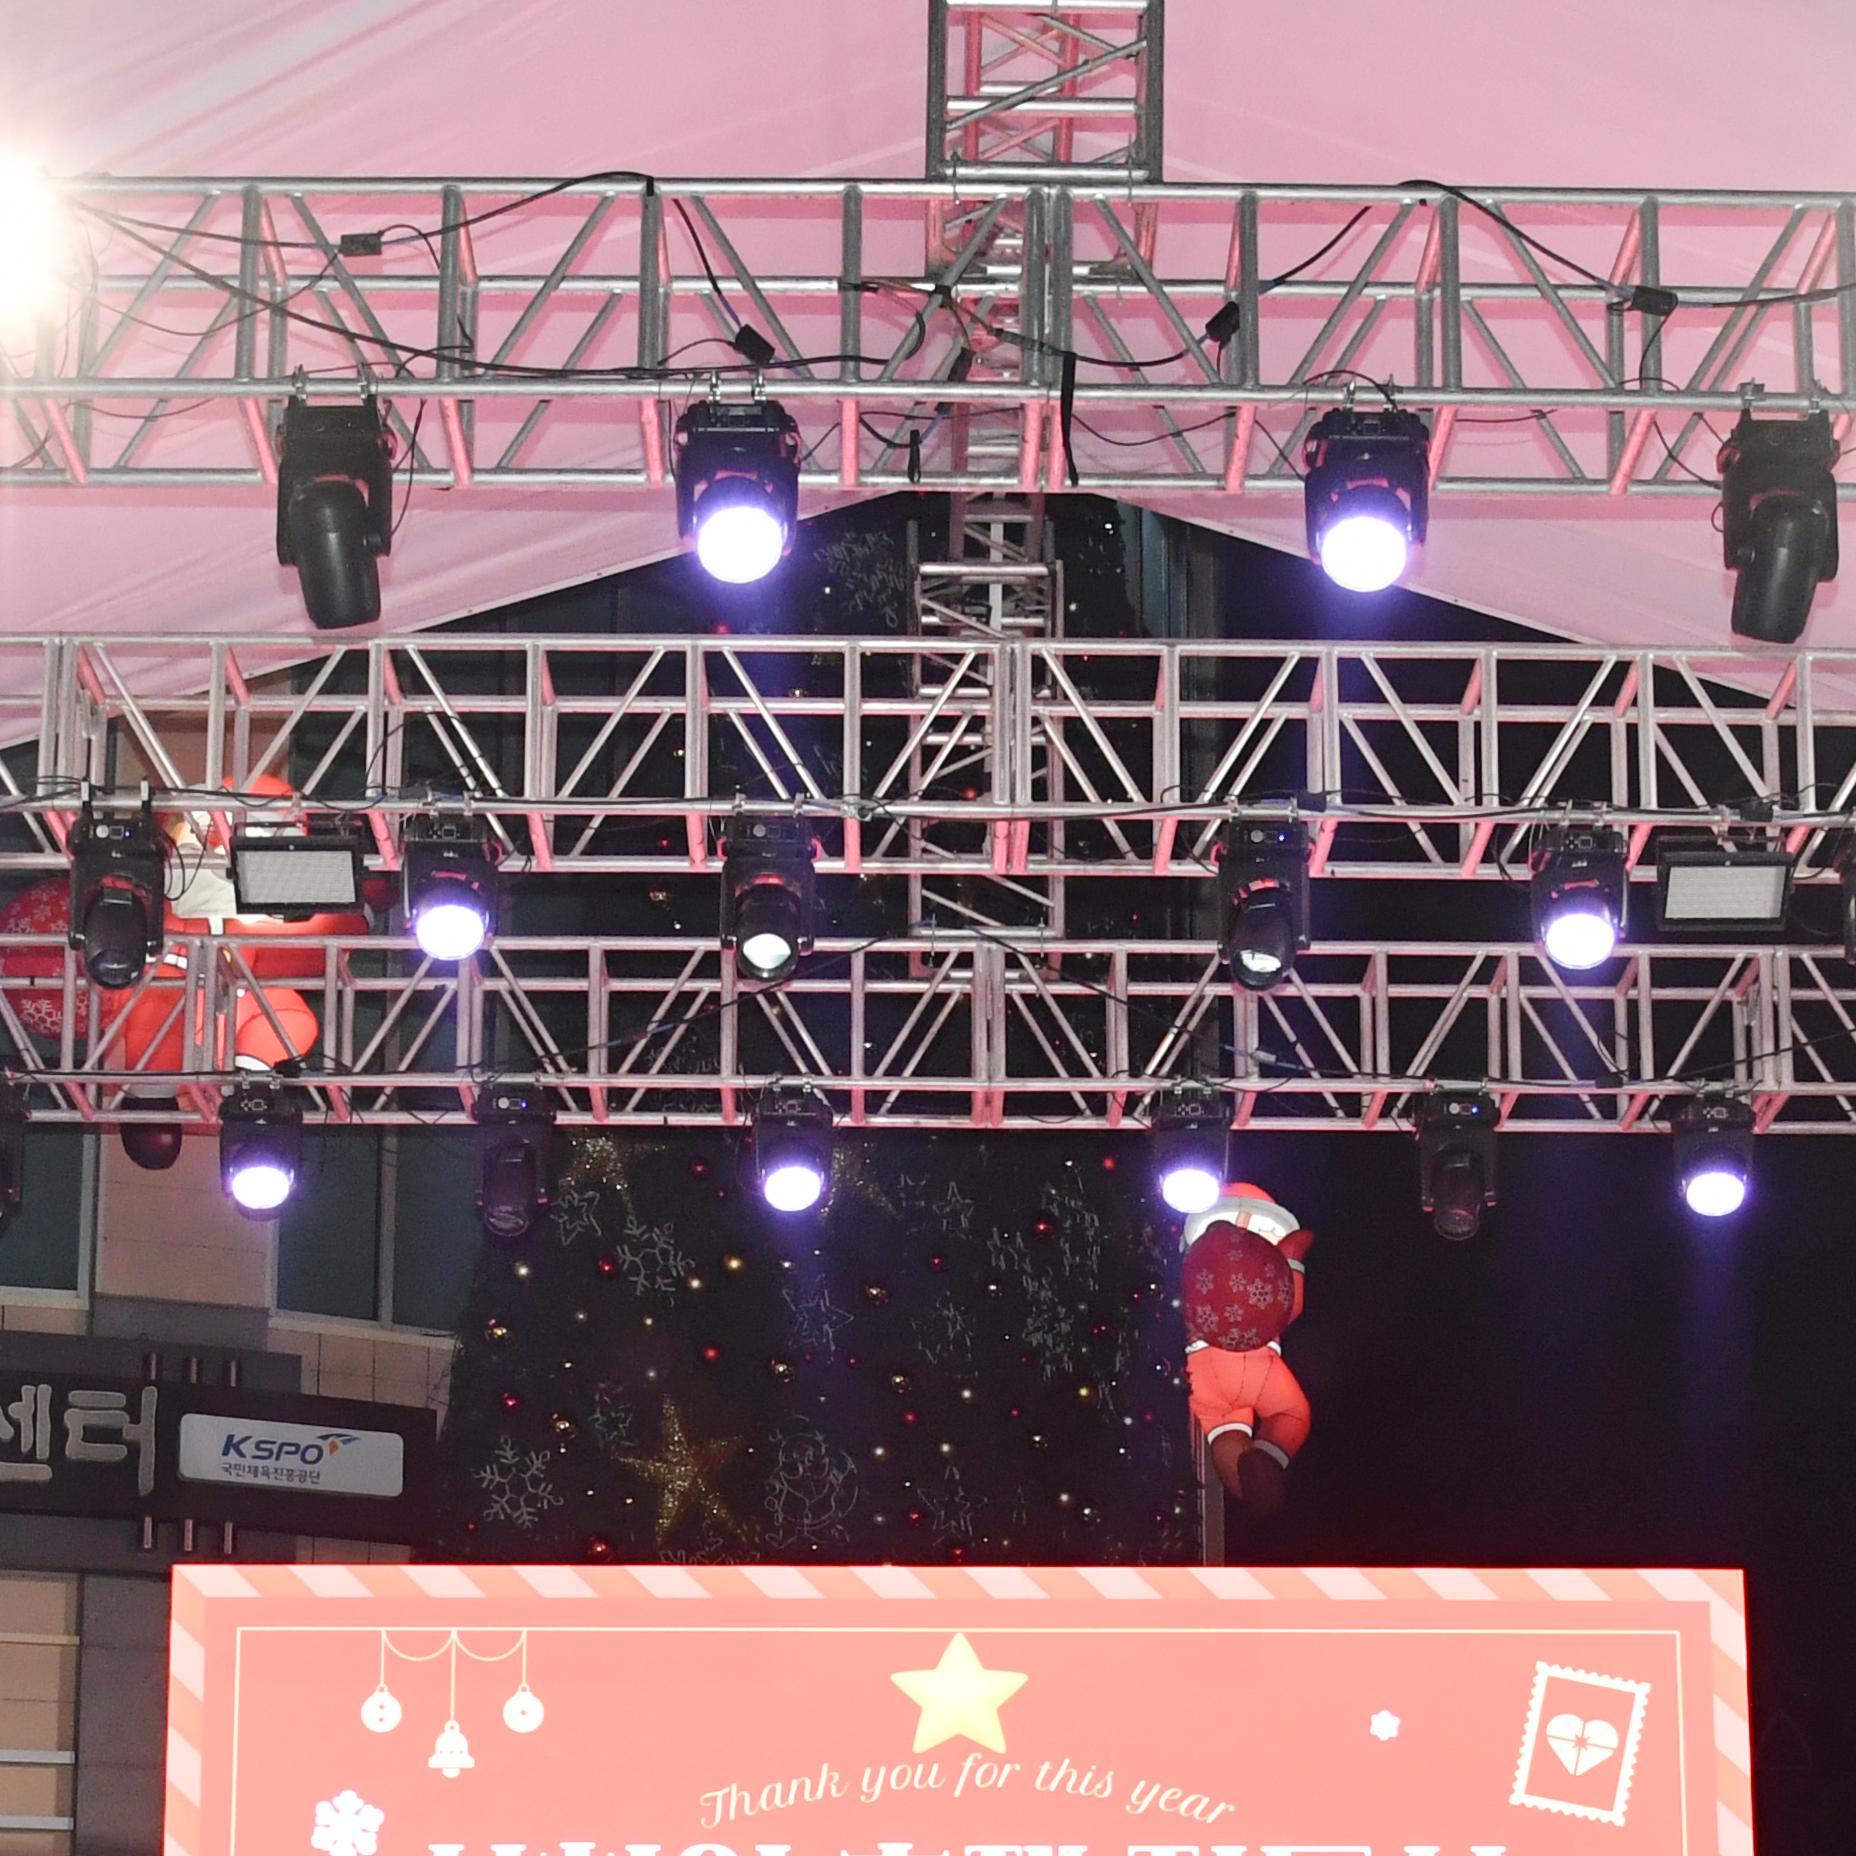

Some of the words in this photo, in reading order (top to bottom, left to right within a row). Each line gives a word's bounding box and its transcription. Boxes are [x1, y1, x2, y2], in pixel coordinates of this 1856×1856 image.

[221, 1433, 324, 1466] KSPO
[221, 1462, 321, 1485] 국민체육진흥공단
[699, 1761, 848, 1830] Thank
[858, 1761, 948, 1803] you
[953, 1752, 1022, 1798] for
[1033, 1757, 1116, 1799] this
[1125, 1779, 1237, 1825] year
